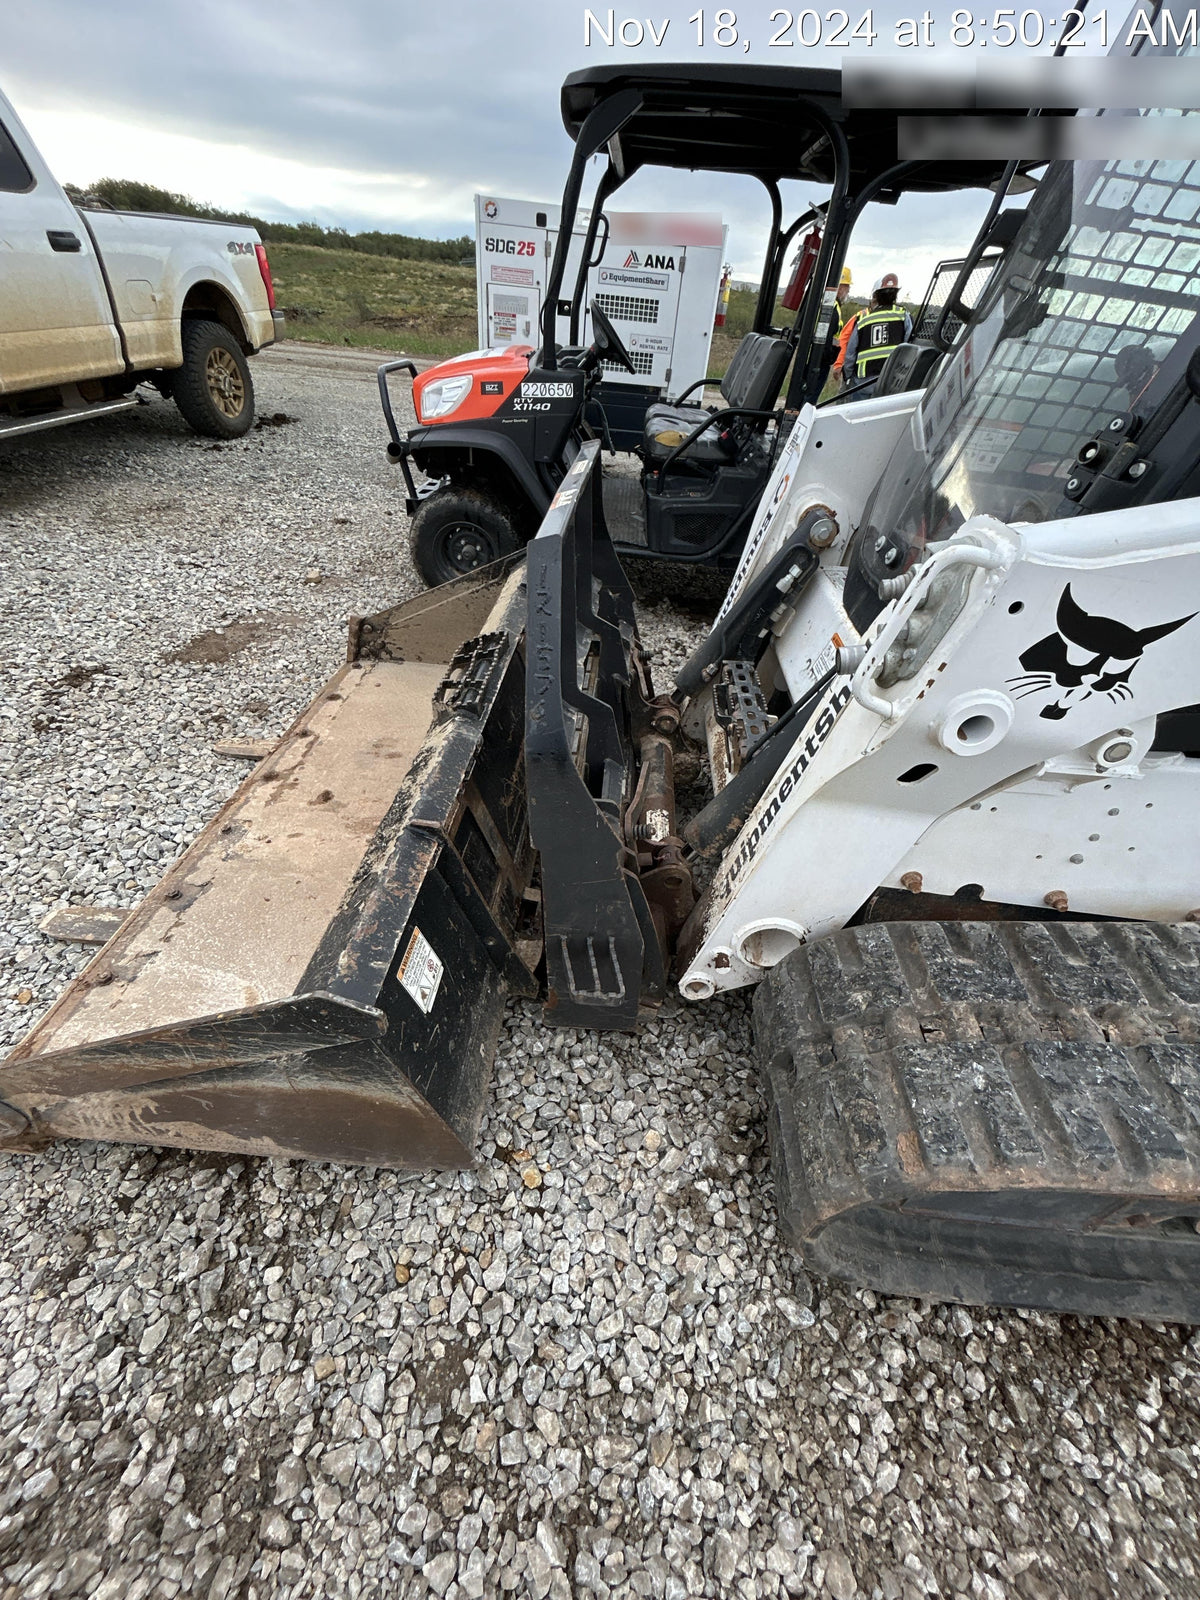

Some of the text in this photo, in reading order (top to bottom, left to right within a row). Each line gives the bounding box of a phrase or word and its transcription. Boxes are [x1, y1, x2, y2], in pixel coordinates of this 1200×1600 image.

[644, 254, 675, 270] ANA
[609, 273, 665, 286] EquipmentShare
[522, 383, 573, 397] 220650
[513, 403, 551, 411] X1140
[402, 934, 417, 969] WARNING
